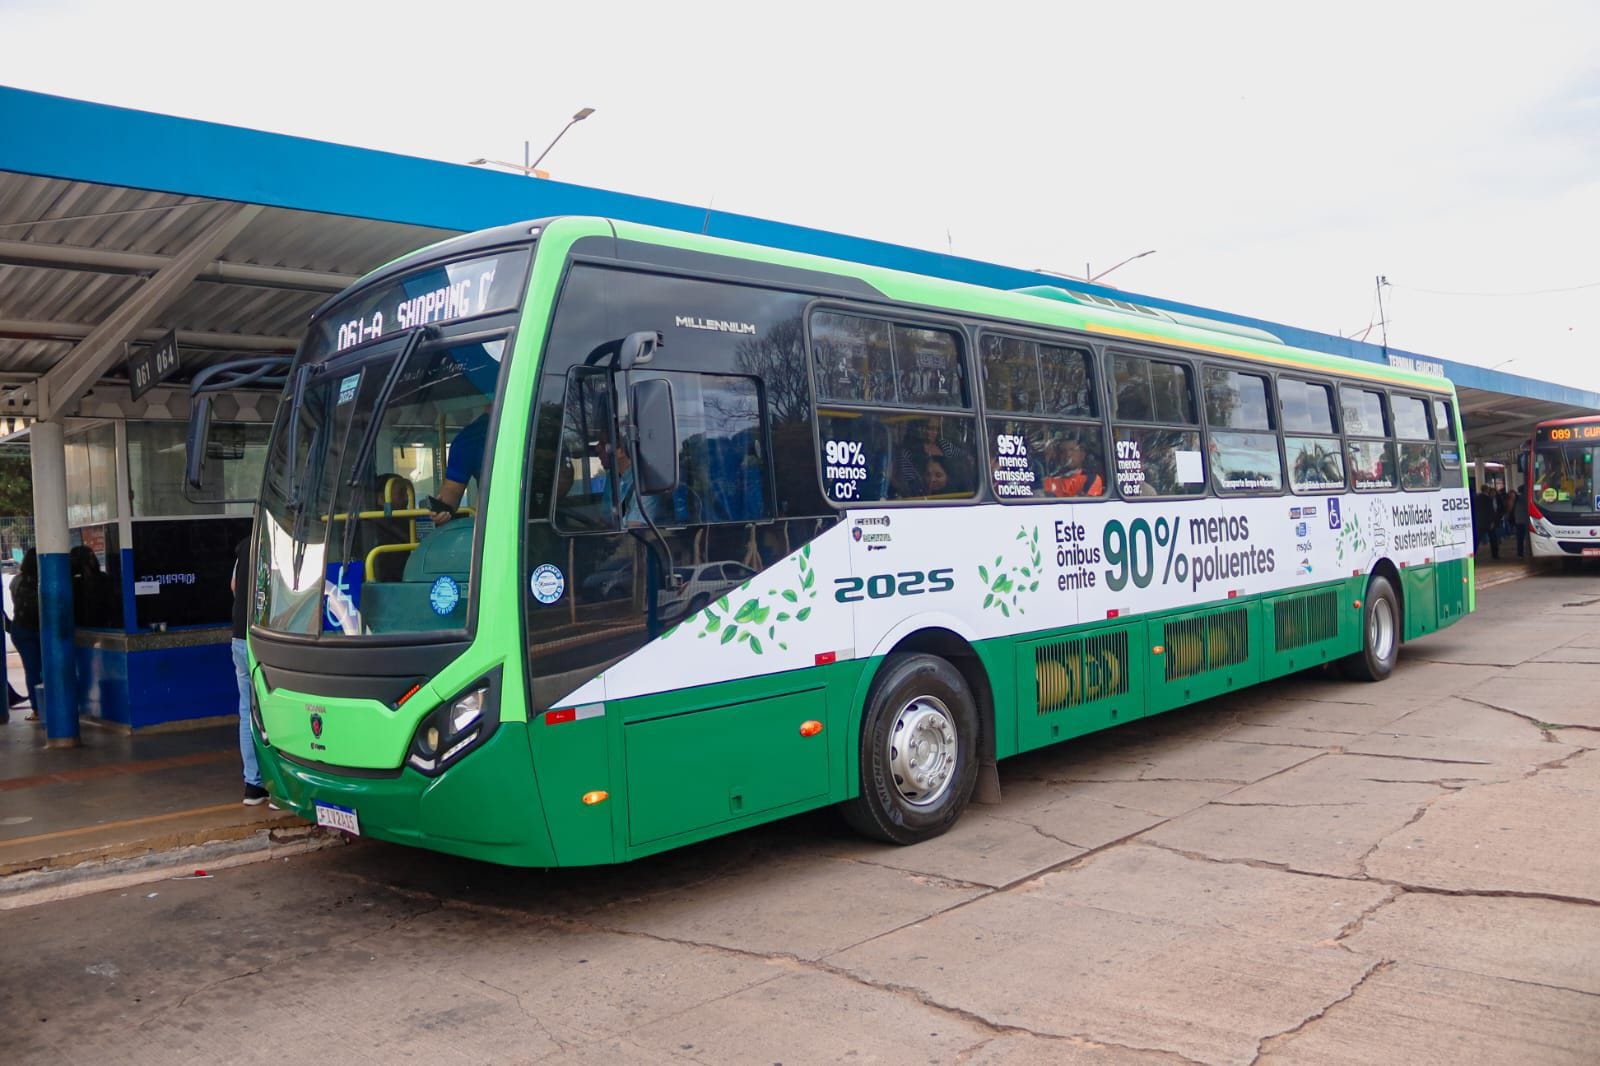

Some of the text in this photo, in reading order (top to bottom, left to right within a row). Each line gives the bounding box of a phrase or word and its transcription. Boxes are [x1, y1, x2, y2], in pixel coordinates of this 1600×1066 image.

[337, 311, 384, 351] 061-A
[397, 279, 471, 329] SHOPPING
[675, 315, 756, 335] MILLENNIUM
[136, 344, 175, 388] 061 064
[1551, 428, 1571, 440] 089
[1573, 427, 1582, 439] T.
[826, 440, 866, 465] 90%
[997, 434, 1027, 456] 95%
[1116, 441, 1141, 459] 97%
[827, 466, 867, 480] menos
[998, 456, 1028, 468] menos
[1118, 459, 1142, 470] menos
[994, 468, 1035, 482] emissões
[1117, 470, 1145, 485] poluição
[998, 482, 1034, 496] nocivas.
[1123, 483, 1133, 494] do
[1441, 497, 1470, 511] 2025
[1392, 504, 1433, 528] Mobilidade
[1055, 520, 1085, 543] Este
[1190, 515, 1249, 545] menos
[1394, 526, 1437, 551] sustentável
[1057, 543, 1101, 568] ônibus
[1102, 515, 1189, 592] 90%
[1058, 566, 1096, 591] emite
[1192, 544, 1275, 592] poluentes
[834, 568, 955, 604] 2025
